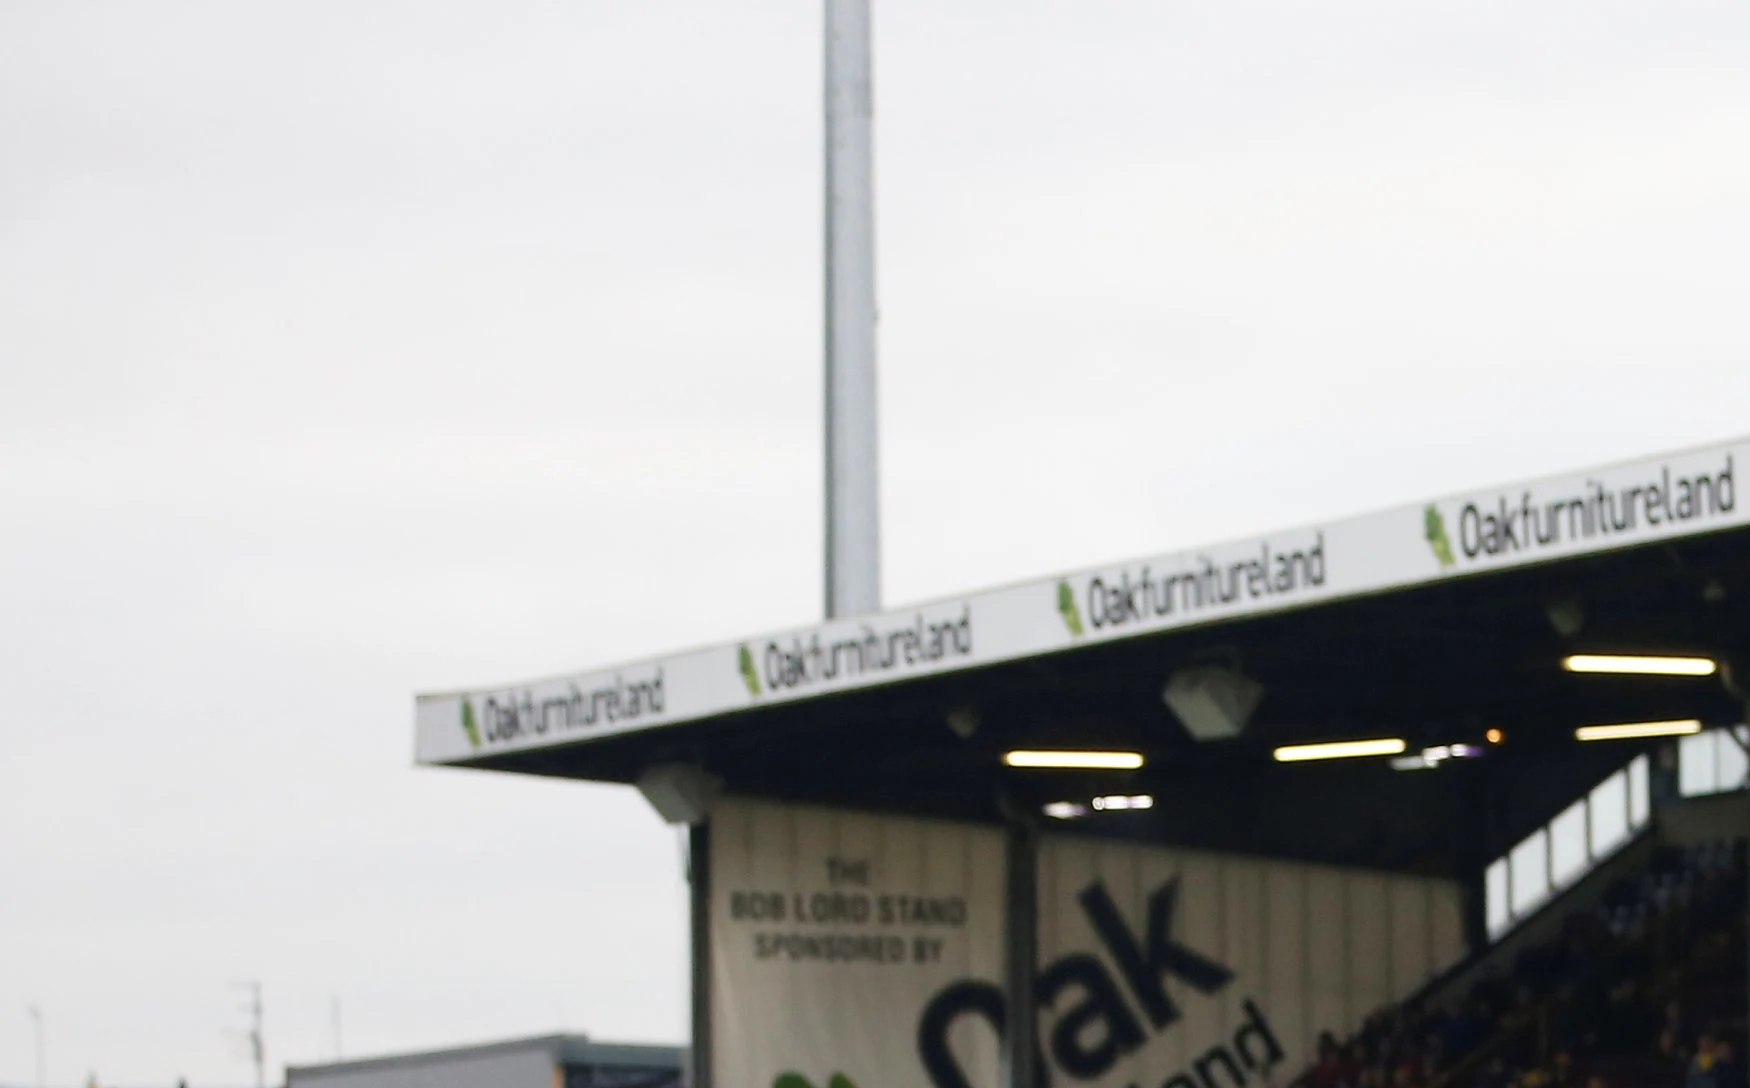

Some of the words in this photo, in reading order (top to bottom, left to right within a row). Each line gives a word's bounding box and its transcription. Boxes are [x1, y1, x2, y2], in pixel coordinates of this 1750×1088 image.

[1459, 456, 1735, 561] Oakfurnitureland
[1088, 533, 1326, 629] Oakfurnitureland
[765, 605, 973, 692] Oakfurnitureland
[484, 668, 665, 744] Oakfurnitureland
[731, 890, 786, 923] BOB
[794, 891, 871, 925] LORD
[878, 893, 968, 928] STAND
[755, 933, 906, 963] SPONSORED
[913, 936, 943, 963] BY
